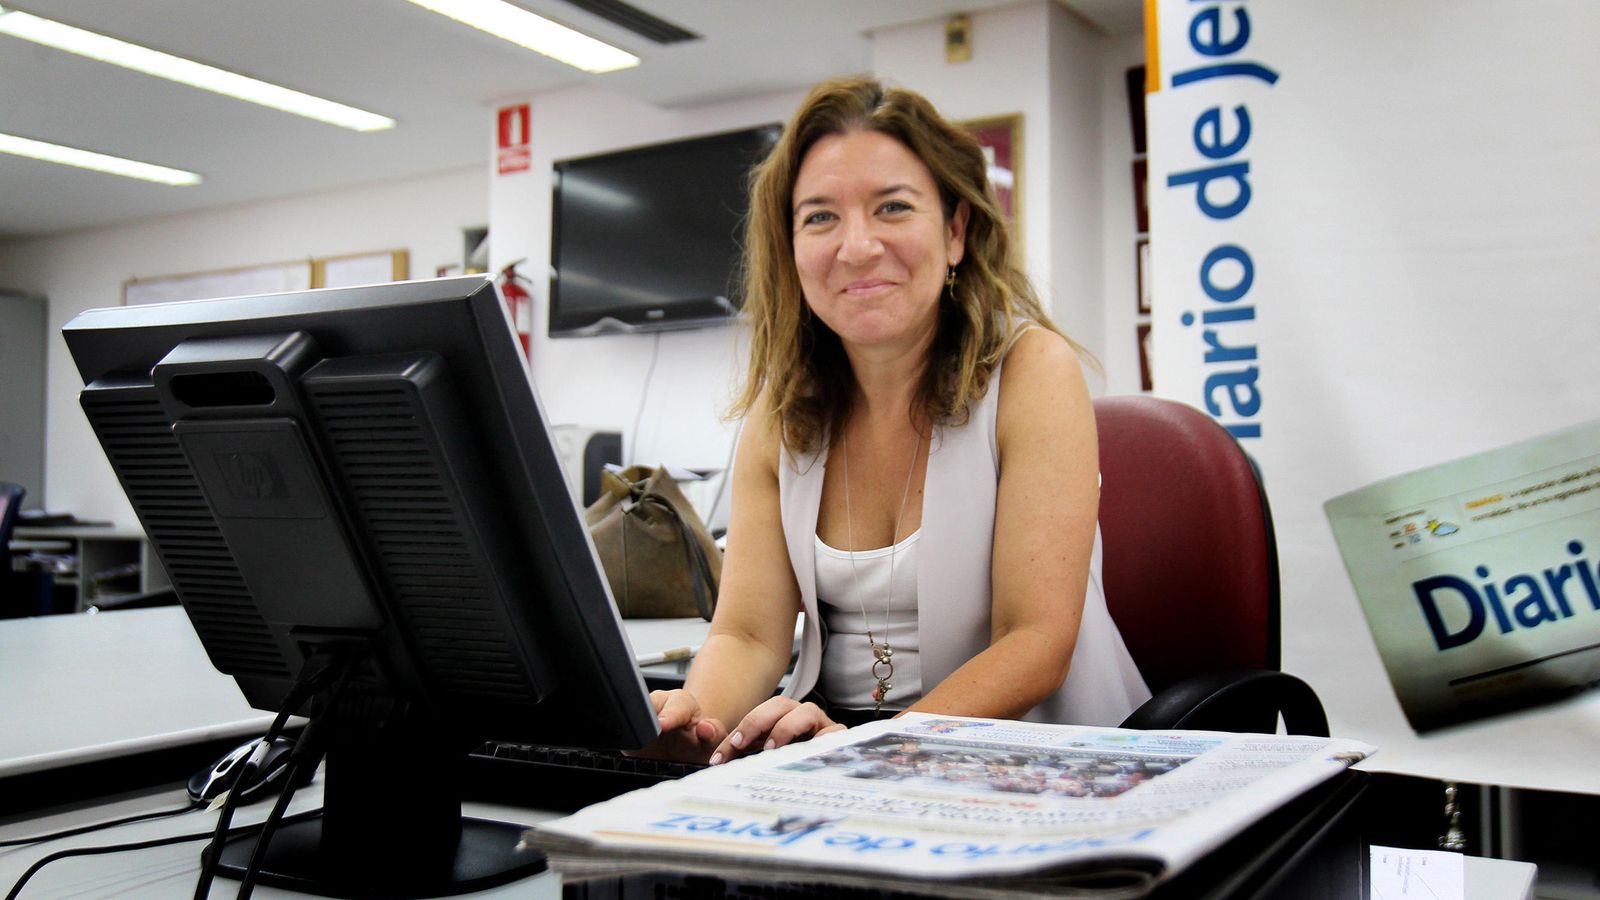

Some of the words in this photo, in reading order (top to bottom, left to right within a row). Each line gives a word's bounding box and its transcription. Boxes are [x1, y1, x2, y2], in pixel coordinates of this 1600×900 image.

[1172, 0, 1279, 87] Je
[1167, 104, 1252, 220] de
[1181, 243, 1261, 438] ario
[1412, 539, 1600, 651] Diari
[823, 831, 917, 853] de
